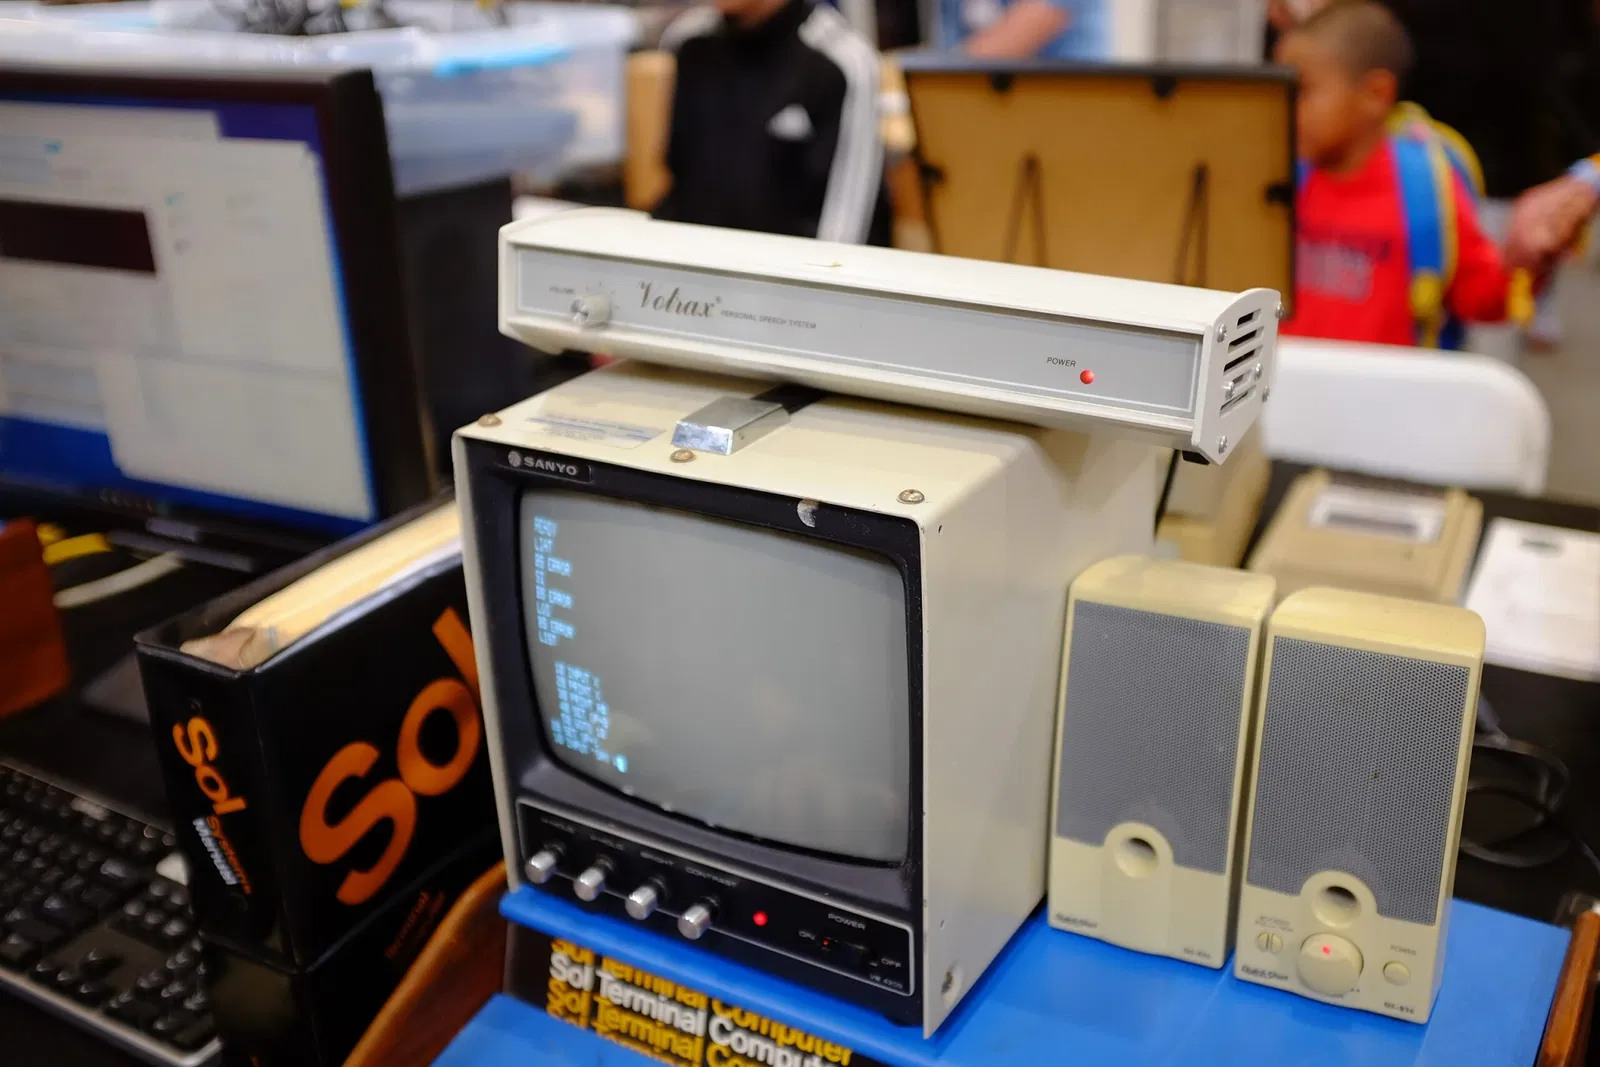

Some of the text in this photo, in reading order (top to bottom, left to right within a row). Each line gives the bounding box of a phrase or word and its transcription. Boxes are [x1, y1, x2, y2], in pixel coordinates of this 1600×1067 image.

[720, 309, 756, 322] PERSONAL
[759, 315, 787, 326] SPEECH
[788, 319, 817, 330] SYSTEM
[1046, 356, 1076, 368] POWER
[523, 456, 578, 476] SANYO
[172, 716, 248, 816] Sol
[828, 912, 867, 931] POWER
[881, 957, 902, 969] OFF
[550, 951, 594, 992] Sol
[596, 968, 708, 1037] Terminal
